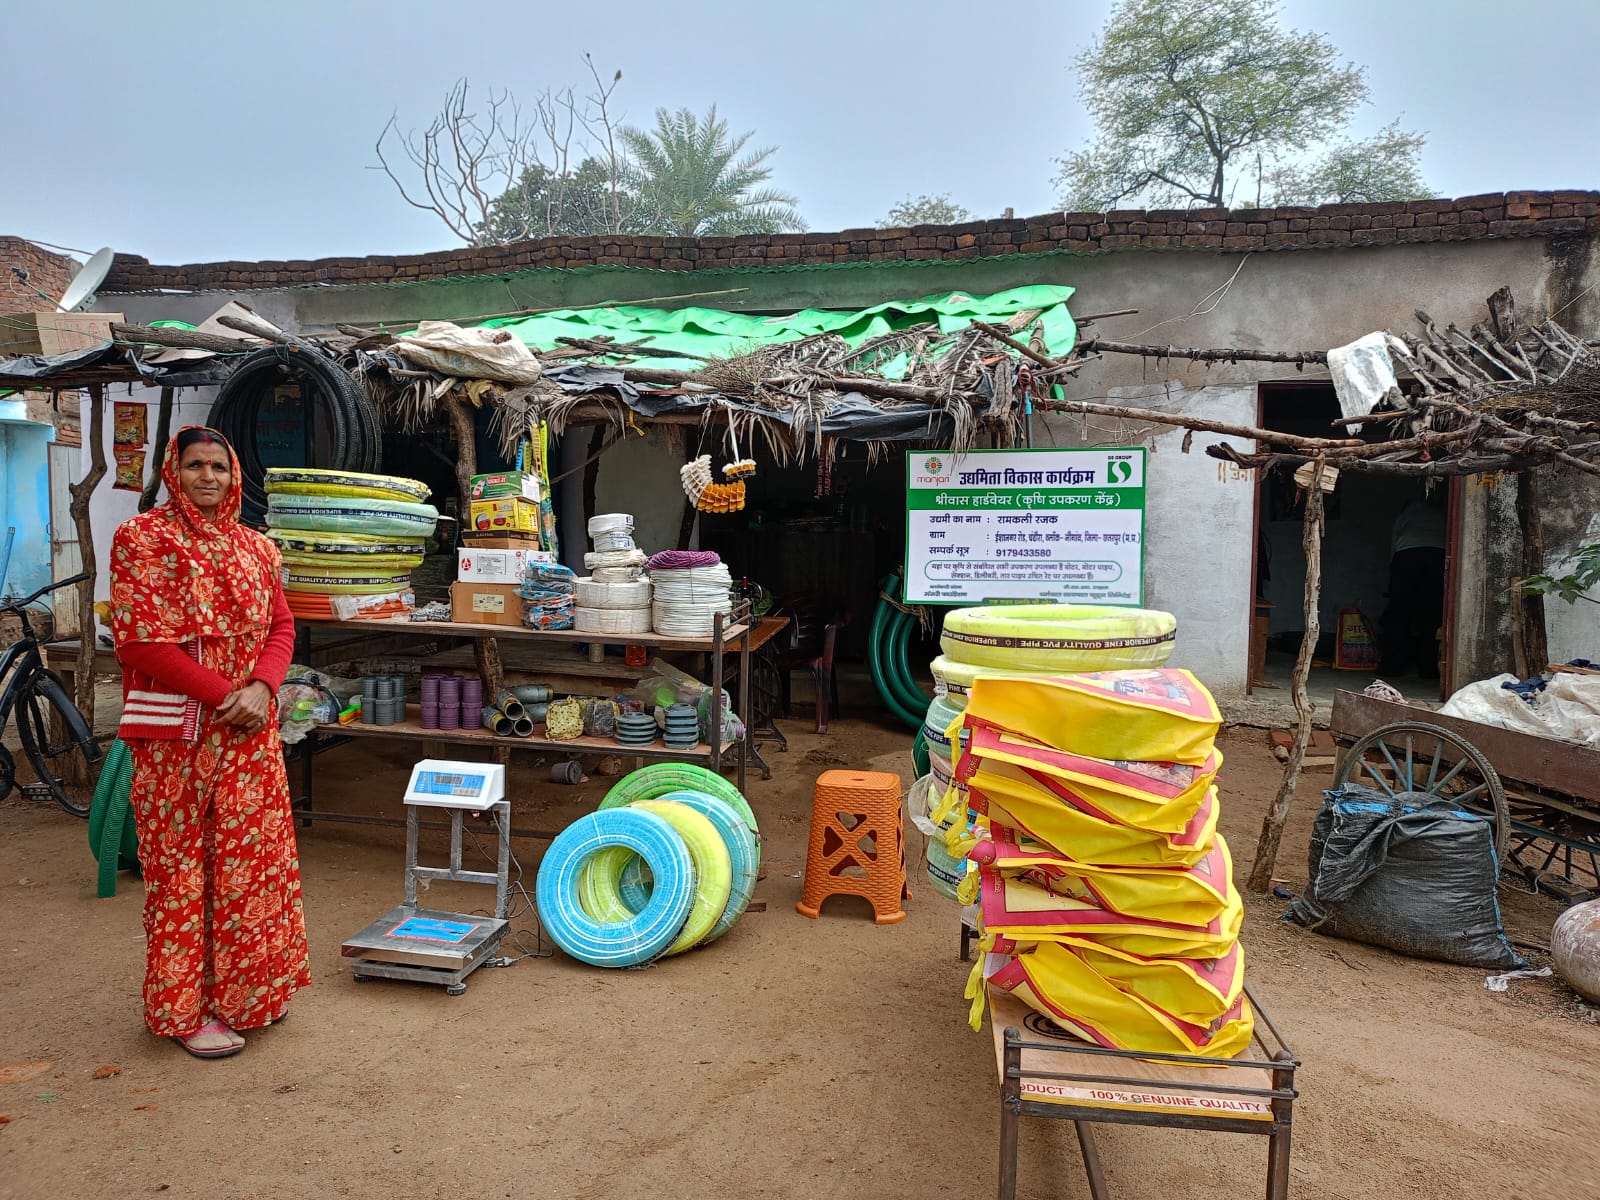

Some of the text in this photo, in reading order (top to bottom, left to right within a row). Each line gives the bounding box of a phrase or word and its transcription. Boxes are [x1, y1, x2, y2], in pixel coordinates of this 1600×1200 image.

[959, 467, 1096, 486] उद्यमिता विकास कार्यक्रम
[935, 492, 970, 506] श्रीवास
[1048, 495, 1091, 505] उपकरण
[929, 512, 951, 524] उद्यमी
[952, 515, 963, 524] का
[965, 515, 981, 524] नाम
[997, 513, 1032, 524] रामकली
[1034, 515, 1059, 524] रजक
[929, 544, 954, 554] सम्पर्क
[955, 546, 970, 557] सूत्र
[995, 549, 1052, 558] 9179433580
[1042, 640, 1060, 648] PVC
[1063, 640, 1102, 649] QUALITY
[1103, 640, 1123, 648] FINE
[1089, 1089, 1128, 1101] 100%
[1131, 1093, 1197, 1107] GENUINE
[1199, 1098, 1261, 1112] QUALITY
